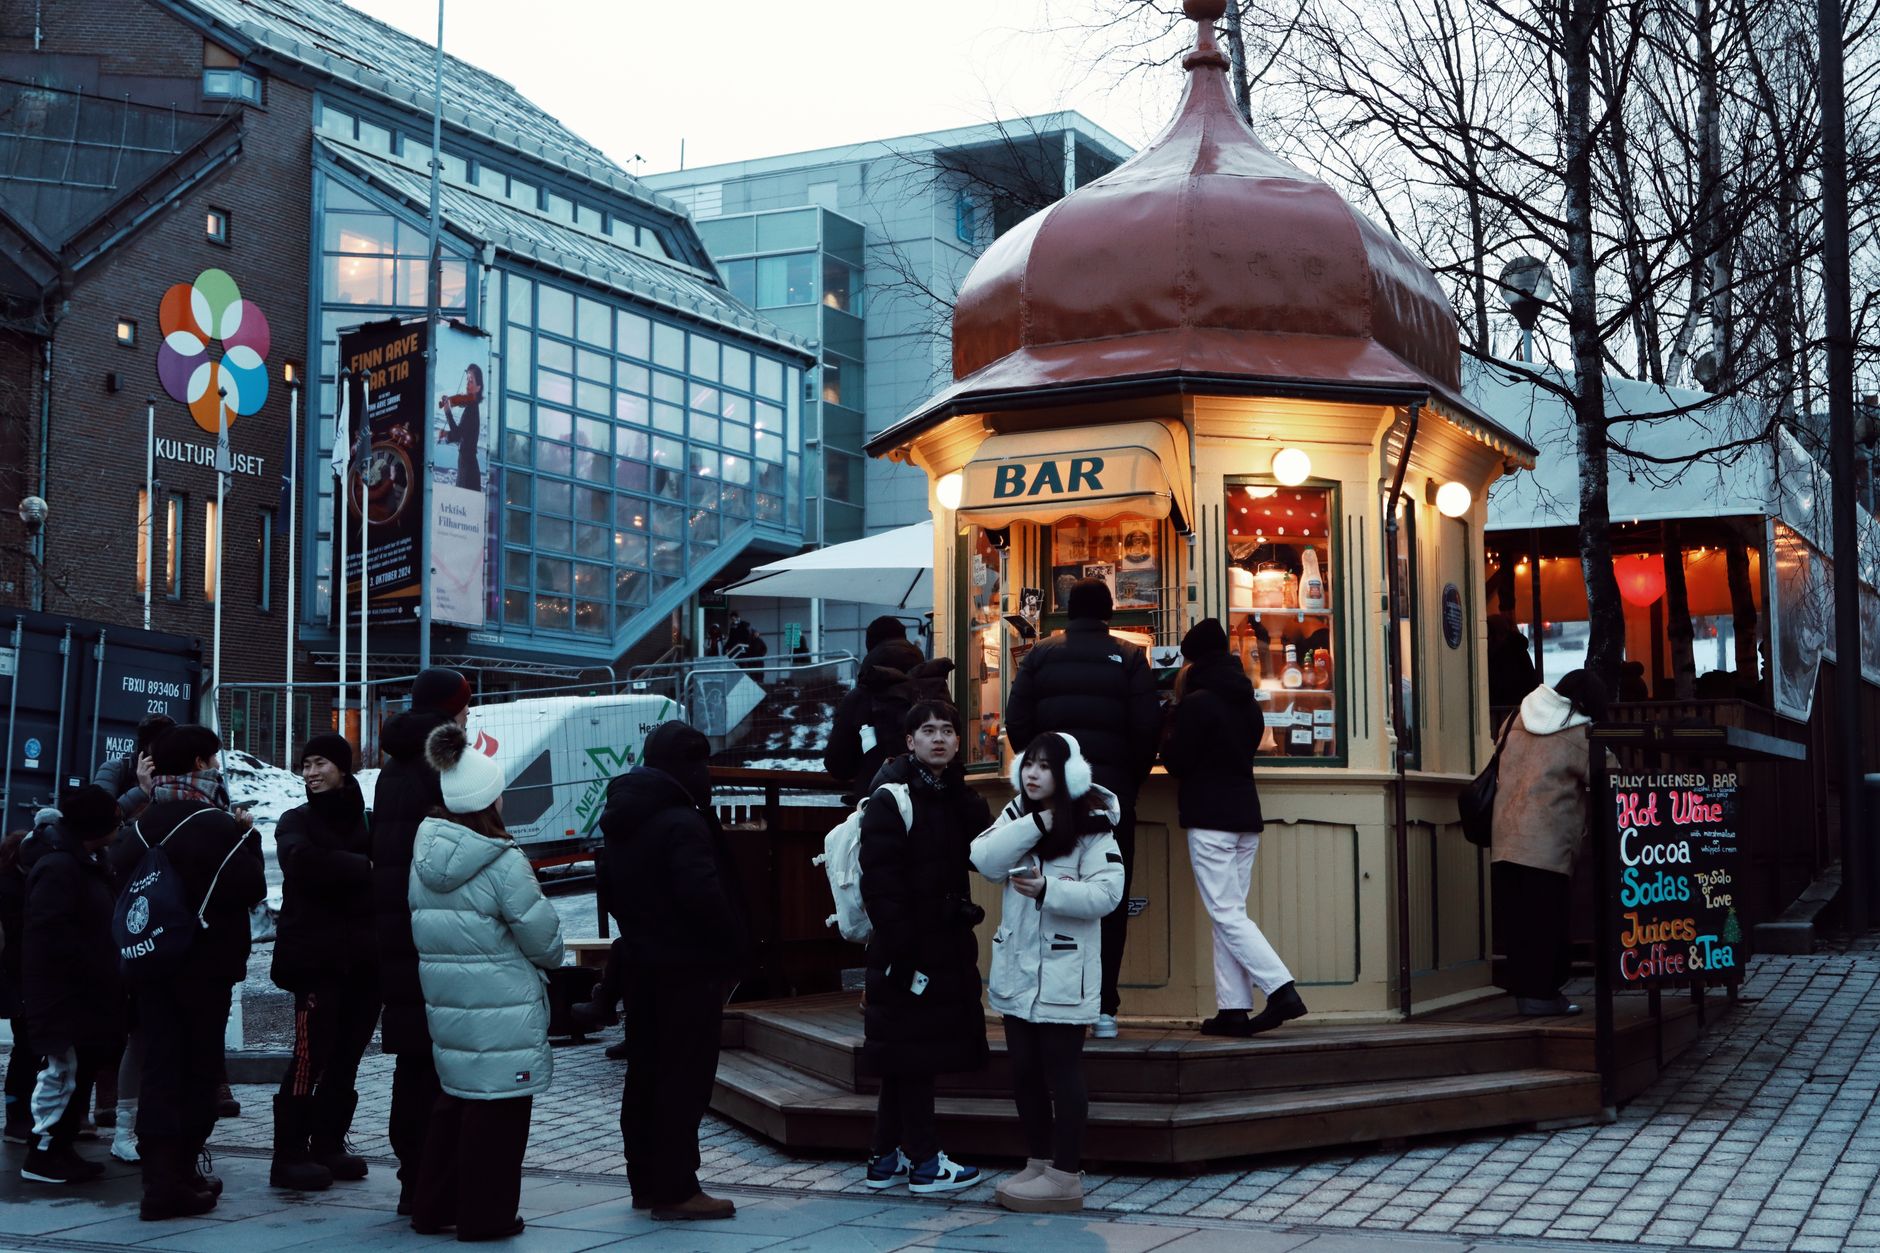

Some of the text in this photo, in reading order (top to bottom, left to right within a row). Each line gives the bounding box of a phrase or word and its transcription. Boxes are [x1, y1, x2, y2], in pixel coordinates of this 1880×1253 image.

[351, 333, 418, 374] FINN ARVE
[361, 360, 409, 391] AR TIA
[155, 437, 264, 476] KULTURUSET
[993, 456, 1104, 498] BAR
[439, 502, 467, 517] Arktisk
[438, 515, 480, 534] Filharmoni
[375, 569, 398, 585] OKTOBER
[398, 565, 411, 579] 2024
[122, 676, 146, 693] FBXU
[147, 680, 180, 698] 893406
[147, 699, 168, 715] 22G1
[1610, 773, 1738, 788] FULLY LICENSED BAR
[575, 771, 604, 819] NEW
[1616, 791, 1662, 829] Hot
[1669, 790, 1723, 825] Wine
[506, 827, 541, 835] twork.com
[1620, 827, 1691, 867] Cocoa
[1700, 844, 1721, 856] whipped
[1620, 867, 1690, 908] Sodas
[1694, 869, 1732, 887] Try Solo
[1701, 885, 1714, 895] or
[1706, 894, 1732, 909] Love
[1621, 911, 1697, 948] Juices
[121, 938, 155, 959] MISU
[1620, 934, 1736, 981] Coffee & Tea
